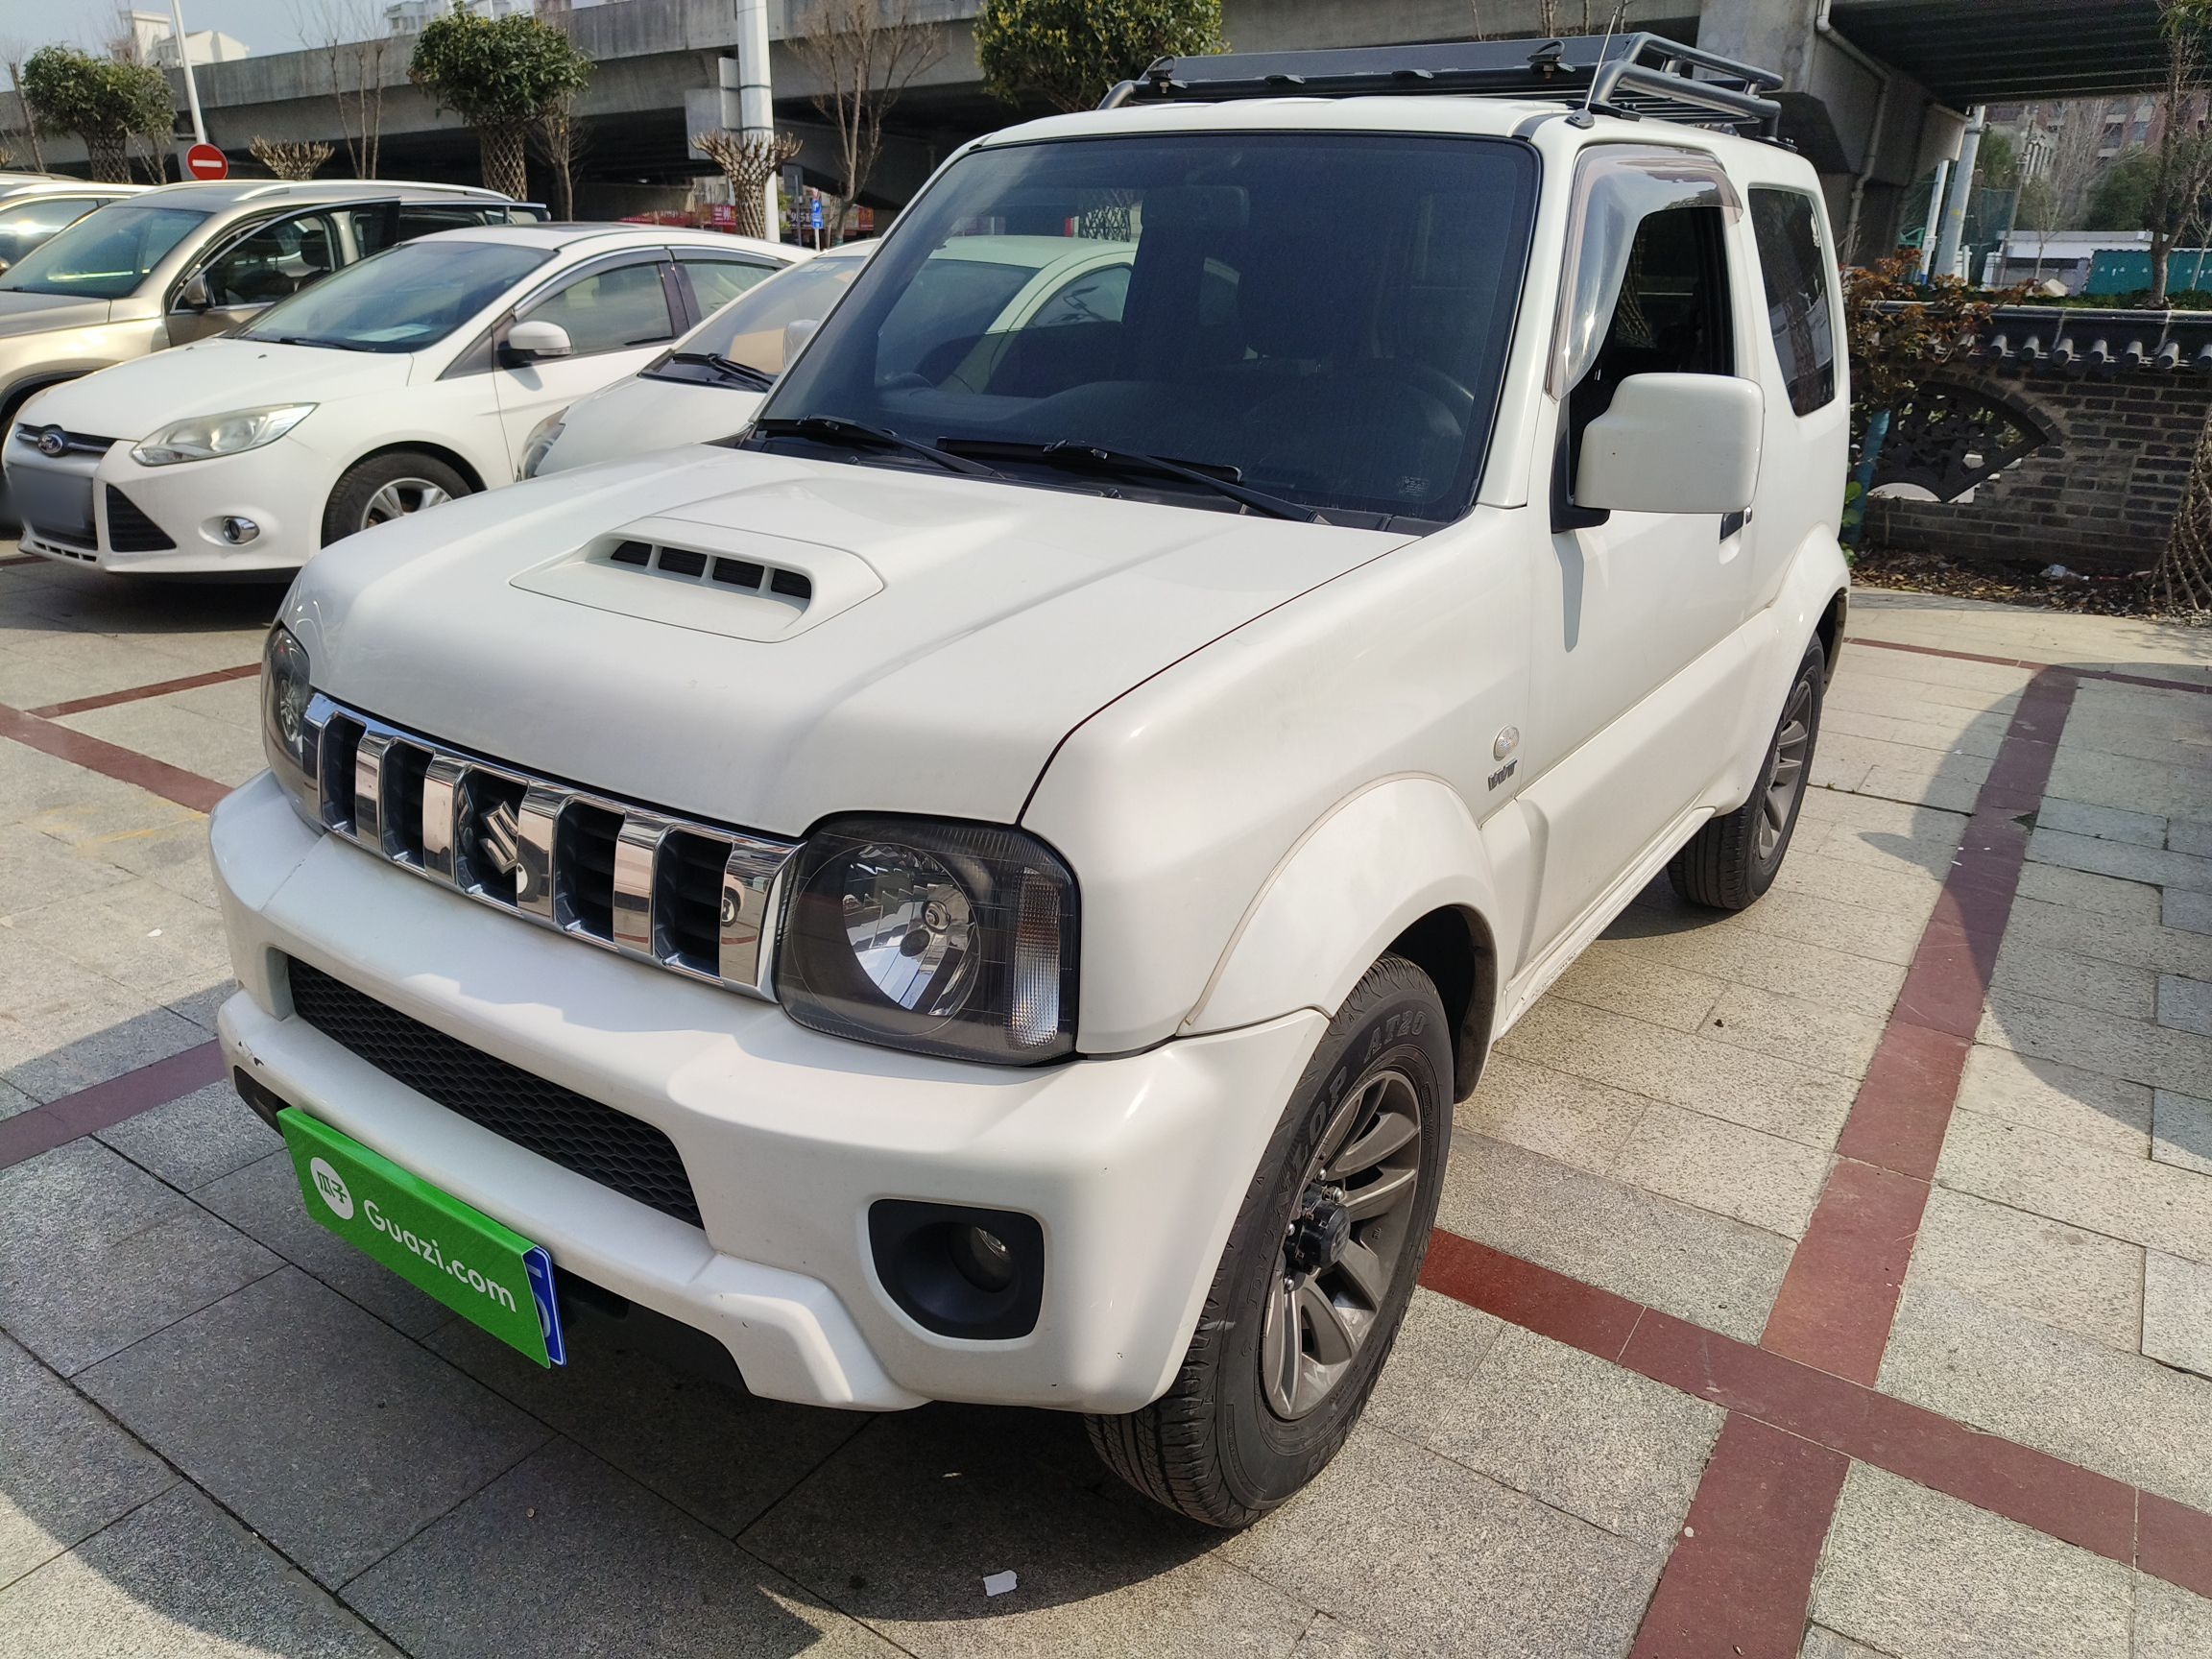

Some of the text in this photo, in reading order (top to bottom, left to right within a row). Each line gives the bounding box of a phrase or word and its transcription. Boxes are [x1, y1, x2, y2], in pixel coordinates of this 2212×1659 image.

[1362, 1009, 1427, 1065] AT20
[316, 1169, 348, 1205] 瓜子
[363, 1198, 517, 1314] Guazi.com
